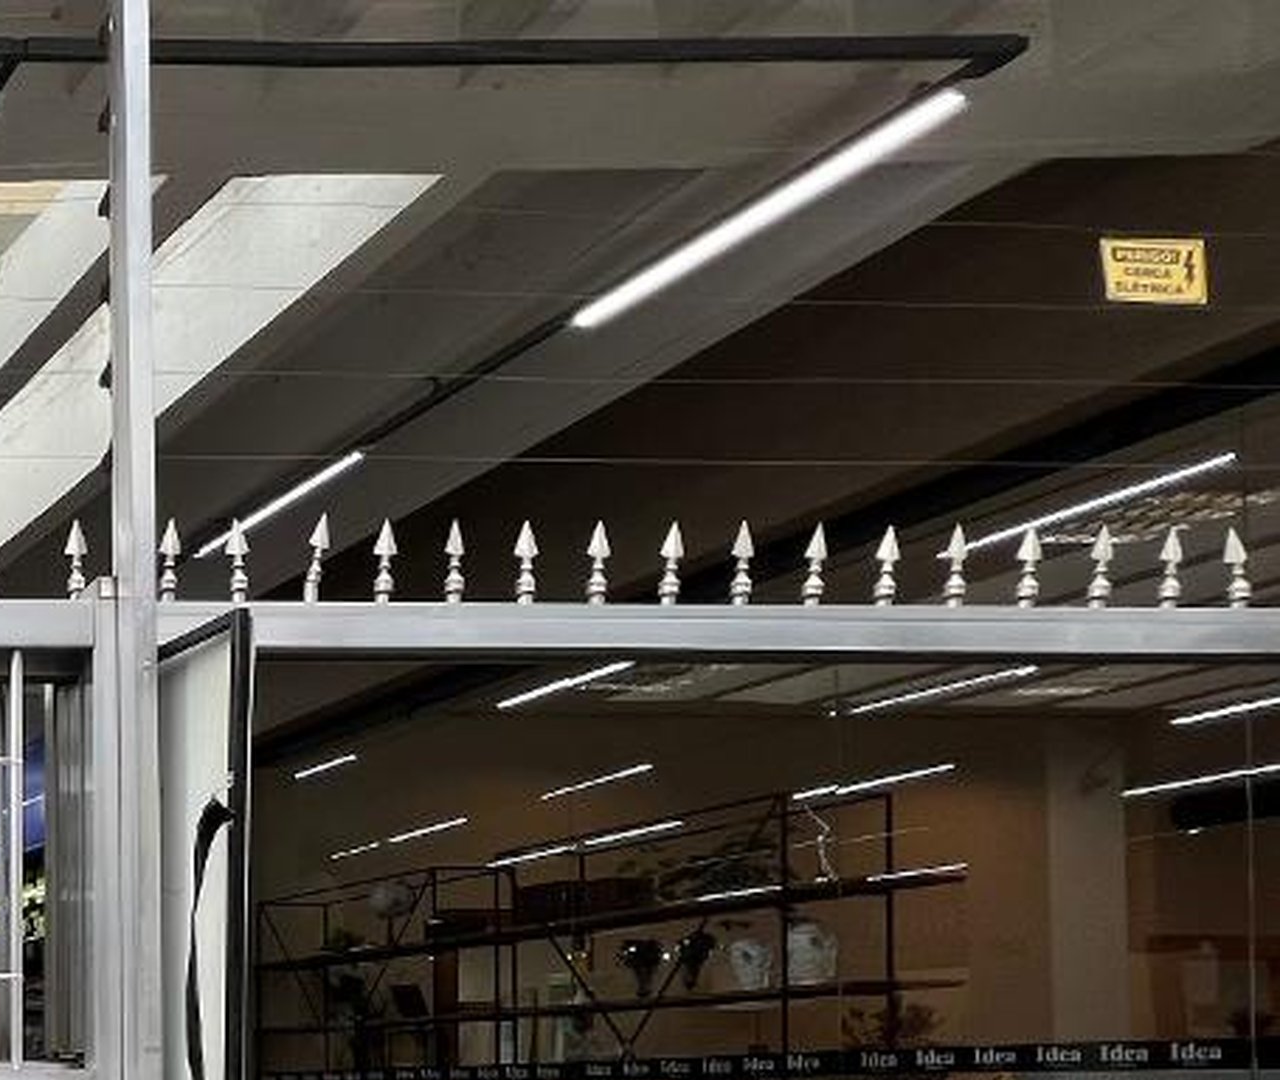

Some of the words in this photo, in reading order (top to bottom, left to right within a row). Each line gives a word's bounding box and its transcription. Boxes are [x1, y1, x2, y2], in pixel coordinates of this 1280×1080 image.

[974, 1048, 1017, 1065] Idea
[1037, 1046, 1082, 1063] Idea
[1099, 1044, 1149, 1063] Idea
[1170, 1042, 1223, 1061] Idea
